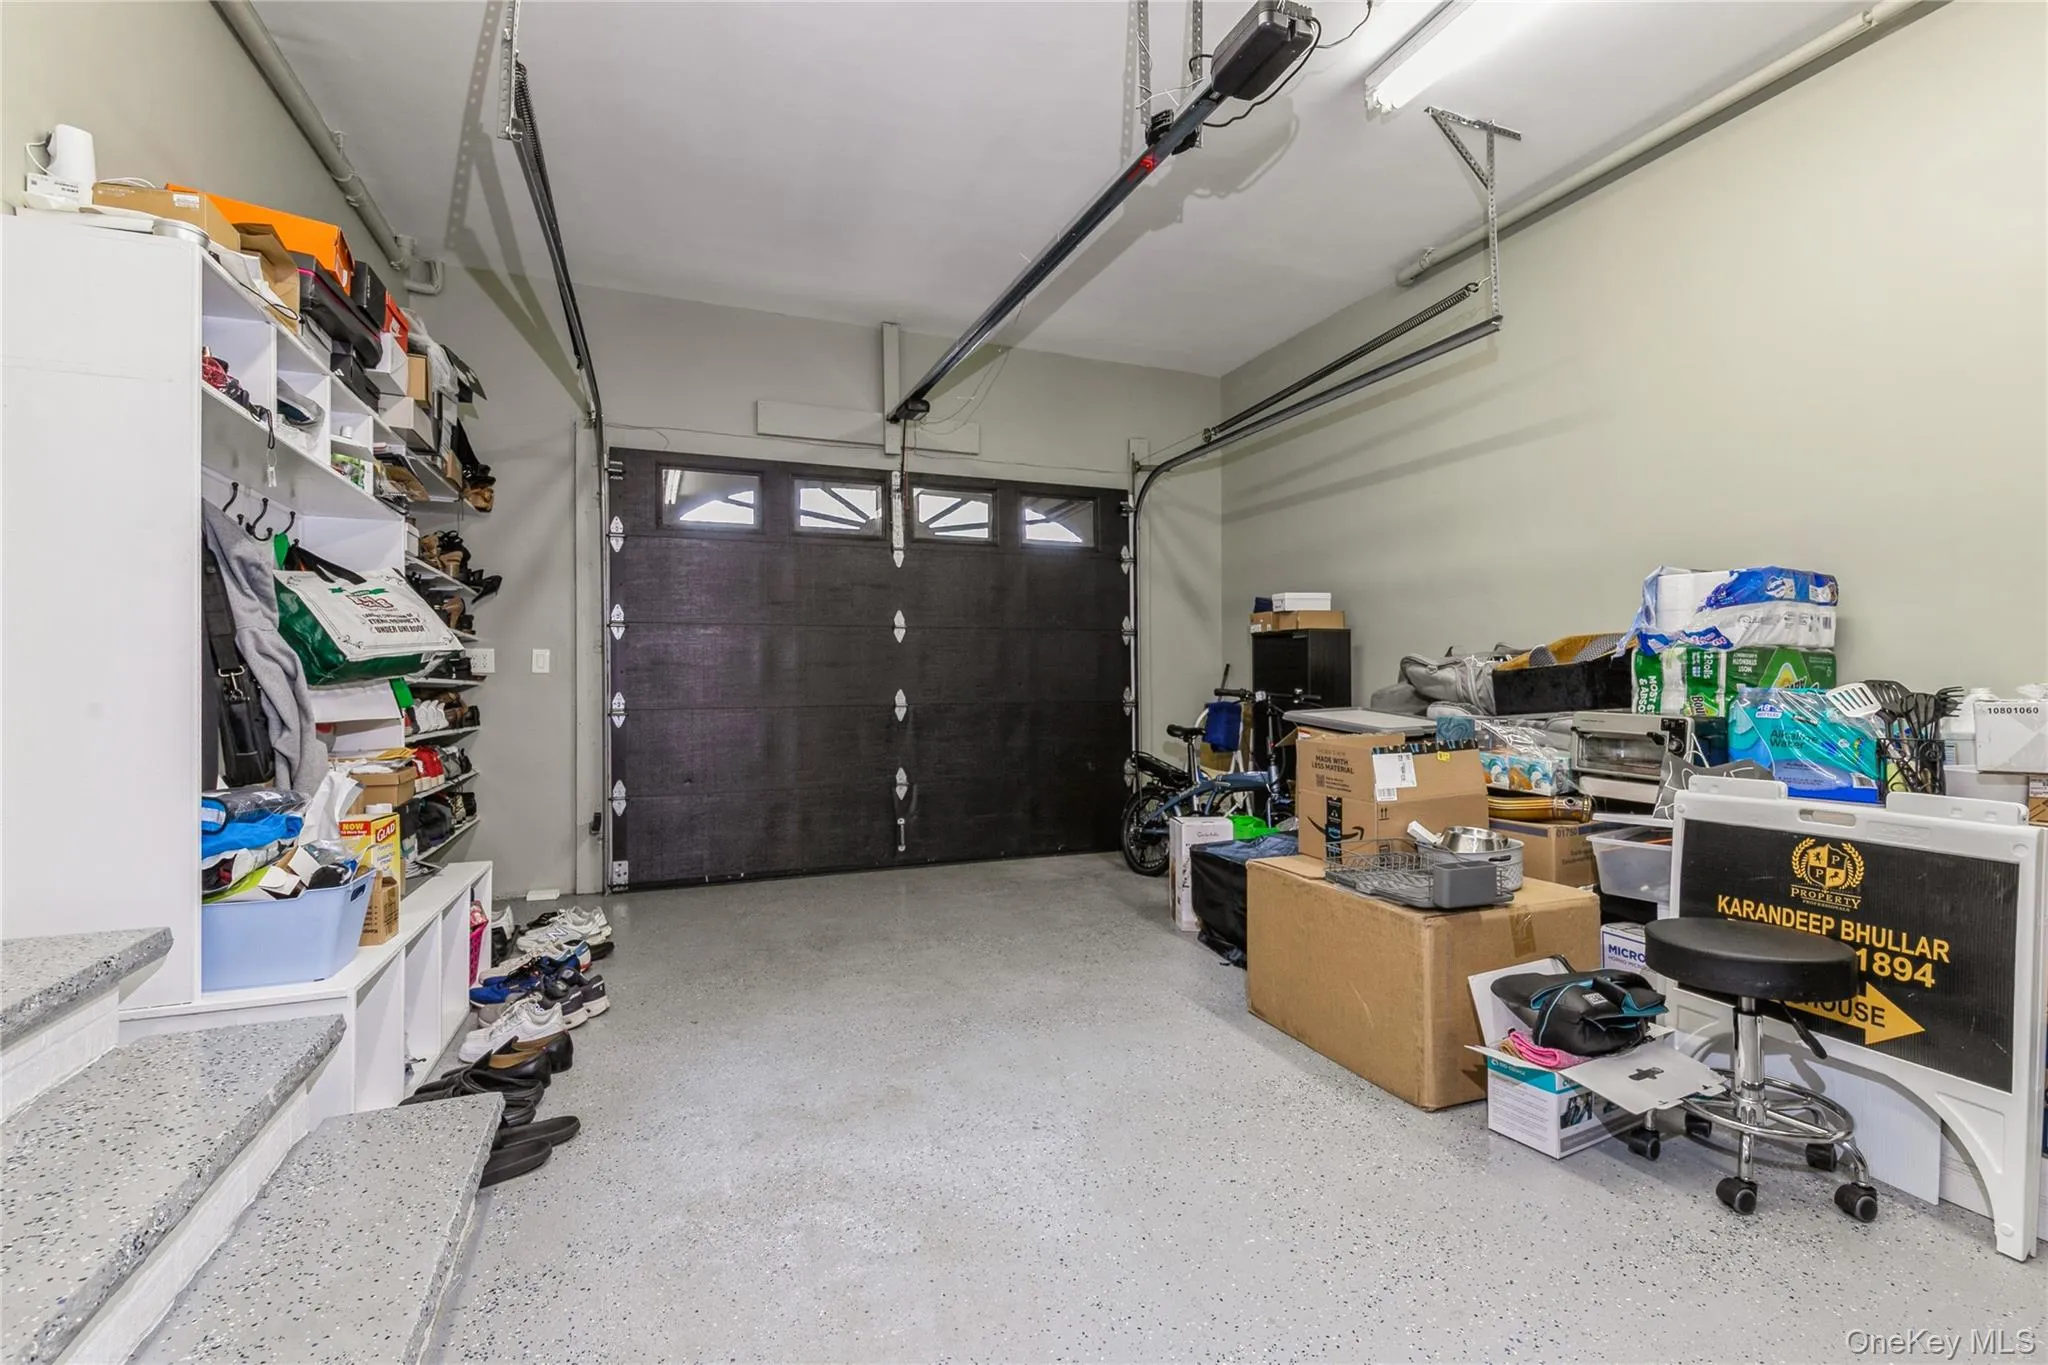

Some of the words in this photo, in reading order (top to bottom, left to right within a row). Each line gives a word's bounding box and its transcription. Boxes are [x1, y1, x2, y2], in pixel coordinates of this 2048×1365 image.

[375, 625, 398, 633] UNDER
[1648, 675, 1658, 703] MOST
[1988, 706, 2039, 715] 10801060
[1311, 761, 1325, 770] LESS
[1324, 763, 1354, 775] MATERIAL
[1315, 755, 1333, 764] MADE
[1333, 757, 1349, 766] WITH
[342, 823, 365, 831] NOW
[376, 823, 396, 842] GLAD
[1791, 887, 1861, 909] PROPERTY
[1718, 894, 1836, 936] KARANDEEP
[1840, 919, 1950, 963] BHULLAR
[1855, 948, 1936, 988] 1894
